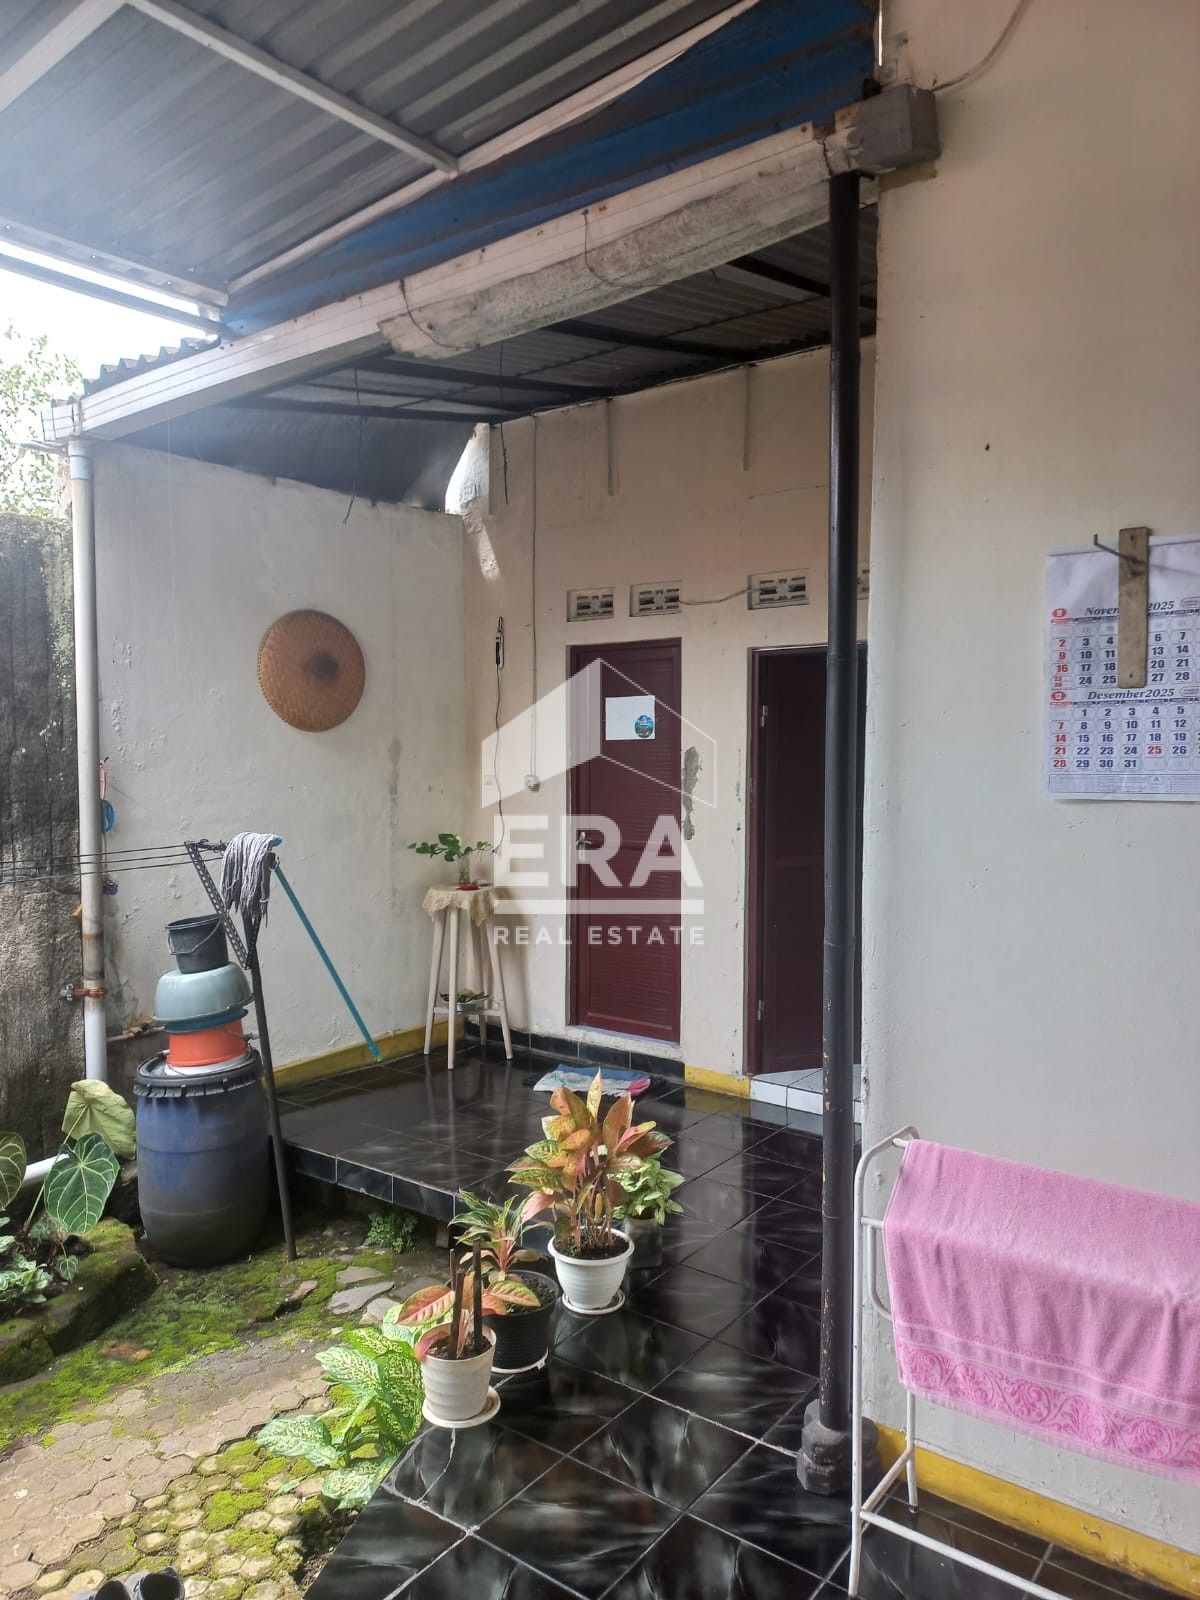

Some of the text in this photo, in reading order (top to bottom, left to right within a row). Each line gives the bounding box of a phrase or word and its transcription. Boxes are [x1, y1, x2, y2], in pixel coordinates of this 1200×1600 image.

[1085, 607, 1119, 616] Nove
[1059, 639, 1065, 647] 2
[1083, 638, 1090, 646] 3
[1155, 634, 1161, 642] 6
[1180, 632, 1186, 640] 7
[1059, 645, 1189, 660] 9 10 11 13 14
[1056, 659, 1189, 673] 16 17 18 20 21
[1079, 672, 1190, 685] 24 25 27 28
[1082, 706, 1184, 717] 1 2 3 4 5
[1104, 721, 1111, 729] 9
[1126, 721, 1138, 729] 10
[1151, 720, 1161, 728] 11
[1078, 734, 1089, 742] 15
[1102, 734, 1113, 742] 16
[1127, 734, 1137, 742] 17
[1150, 733, 1161, 741] 18
[1174, 733, 1186, 741] 19
[1054, 746, 1187, 755] 21 22 23 24 25 26
[1076, 759, 1090, 767] 29
[1099, 759, 1113, 767] 30
[1124, 759, 1136, 767] 31
